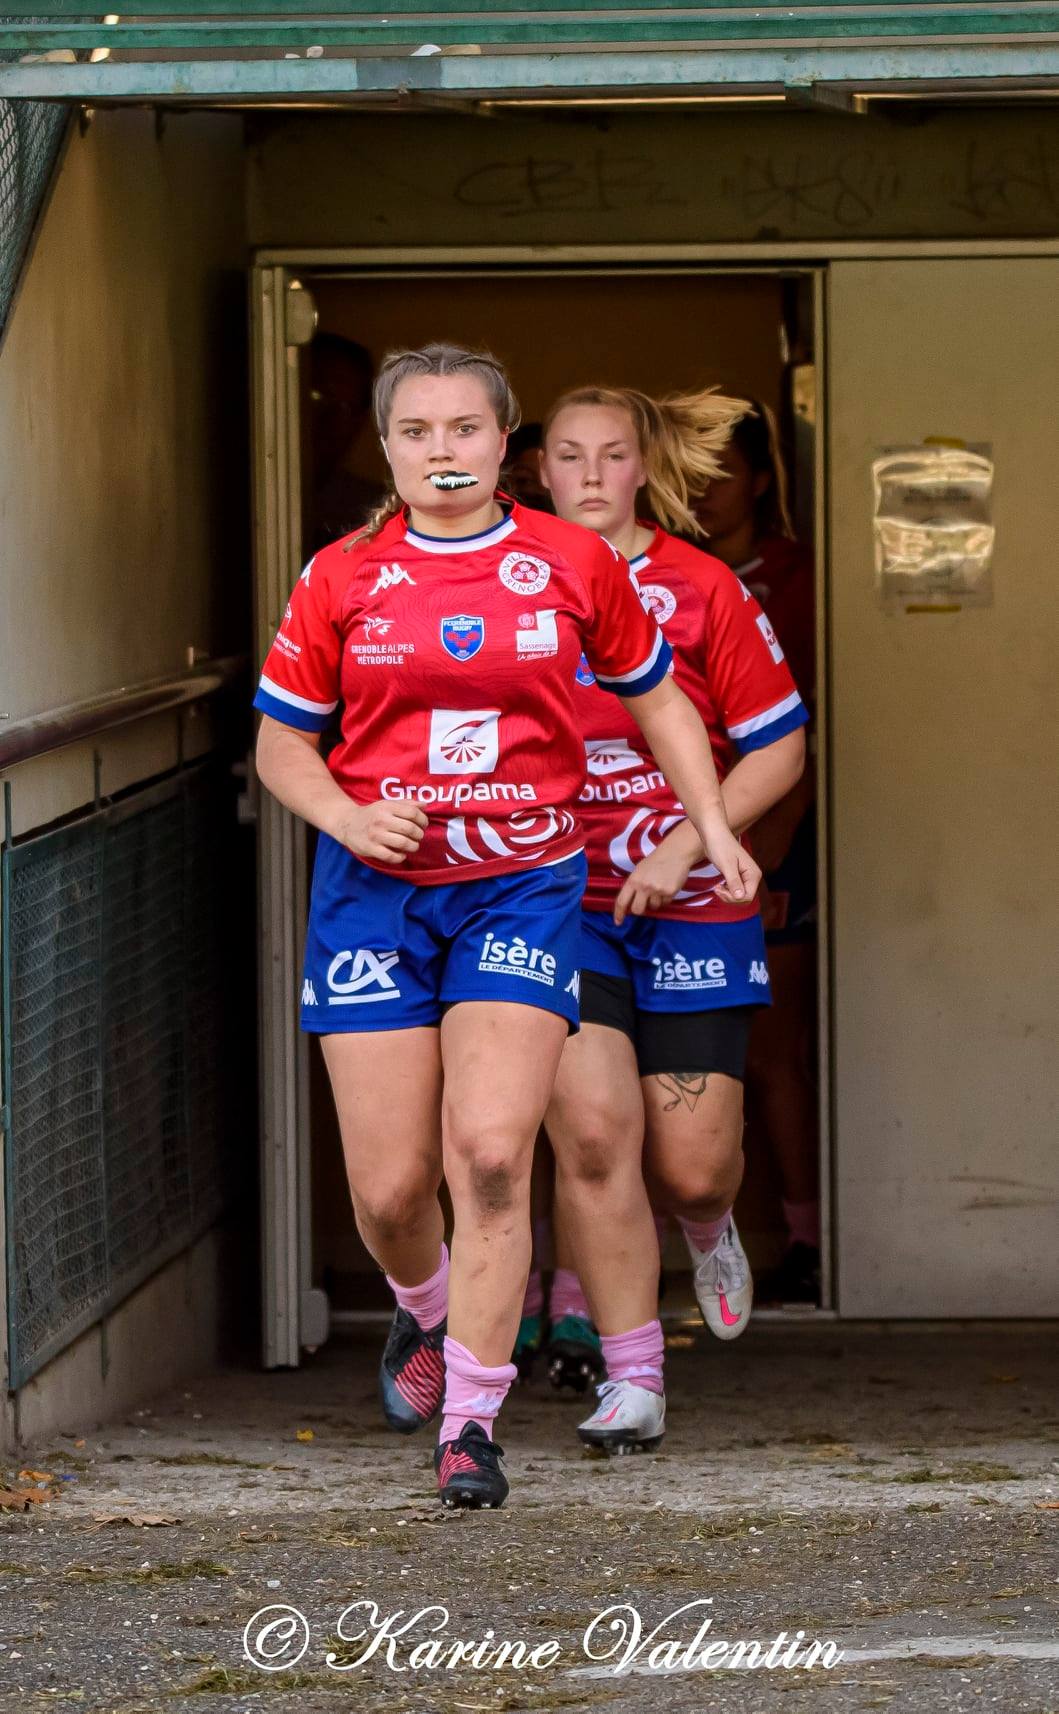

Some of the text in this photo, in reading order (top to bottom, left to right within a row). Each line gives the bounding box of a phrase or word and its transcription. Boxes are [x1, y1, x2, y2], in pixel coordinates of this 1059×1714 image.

[357, 654, 404, 664] MÉTROPOLE
[381, 777, 537, 808] Groupama
[480, 932, 556, 976] isère
[652, 953, 725, 981] isère
